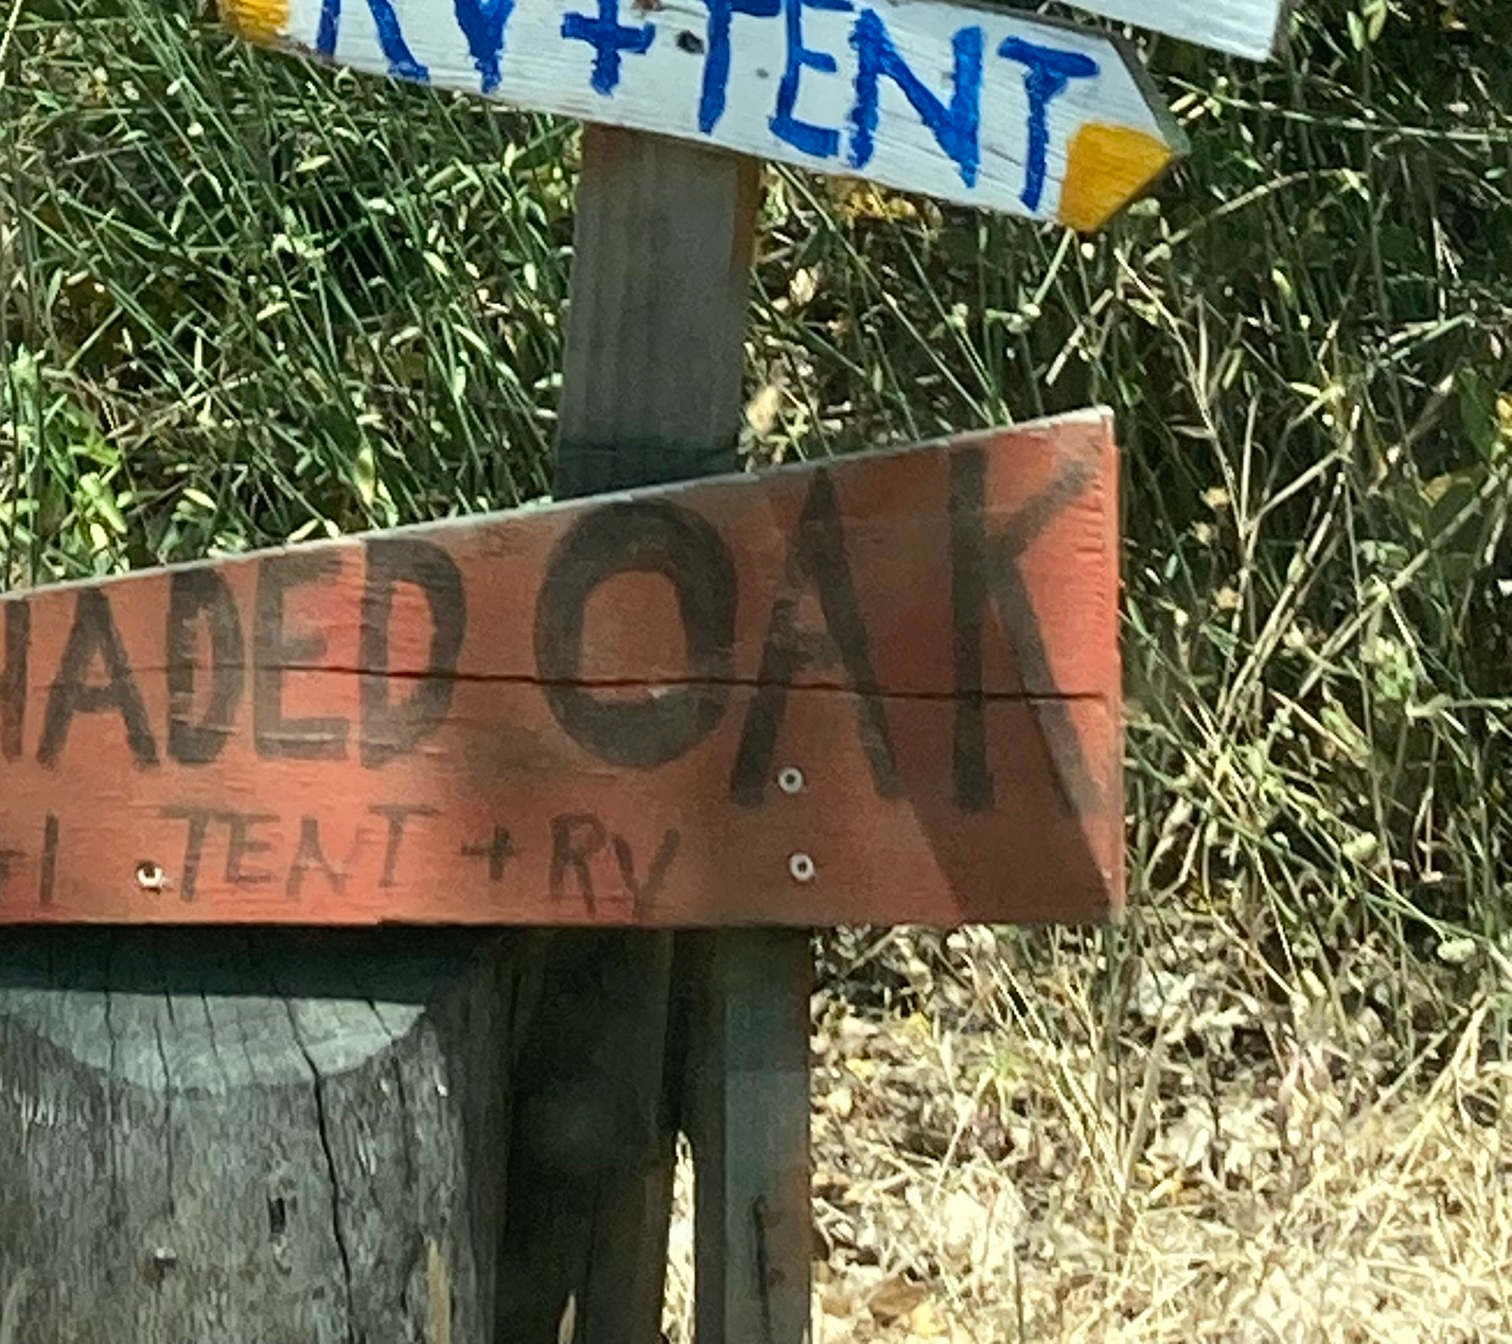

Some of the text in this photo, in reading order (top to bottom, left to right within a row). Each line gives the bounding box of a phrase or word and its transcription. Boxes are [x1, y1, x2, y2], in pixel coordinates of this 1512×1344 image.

[533, 448, 1108, 816] OAK
[170, 802, 439, 904] TENT
[548, 811, 680, 920] RV
